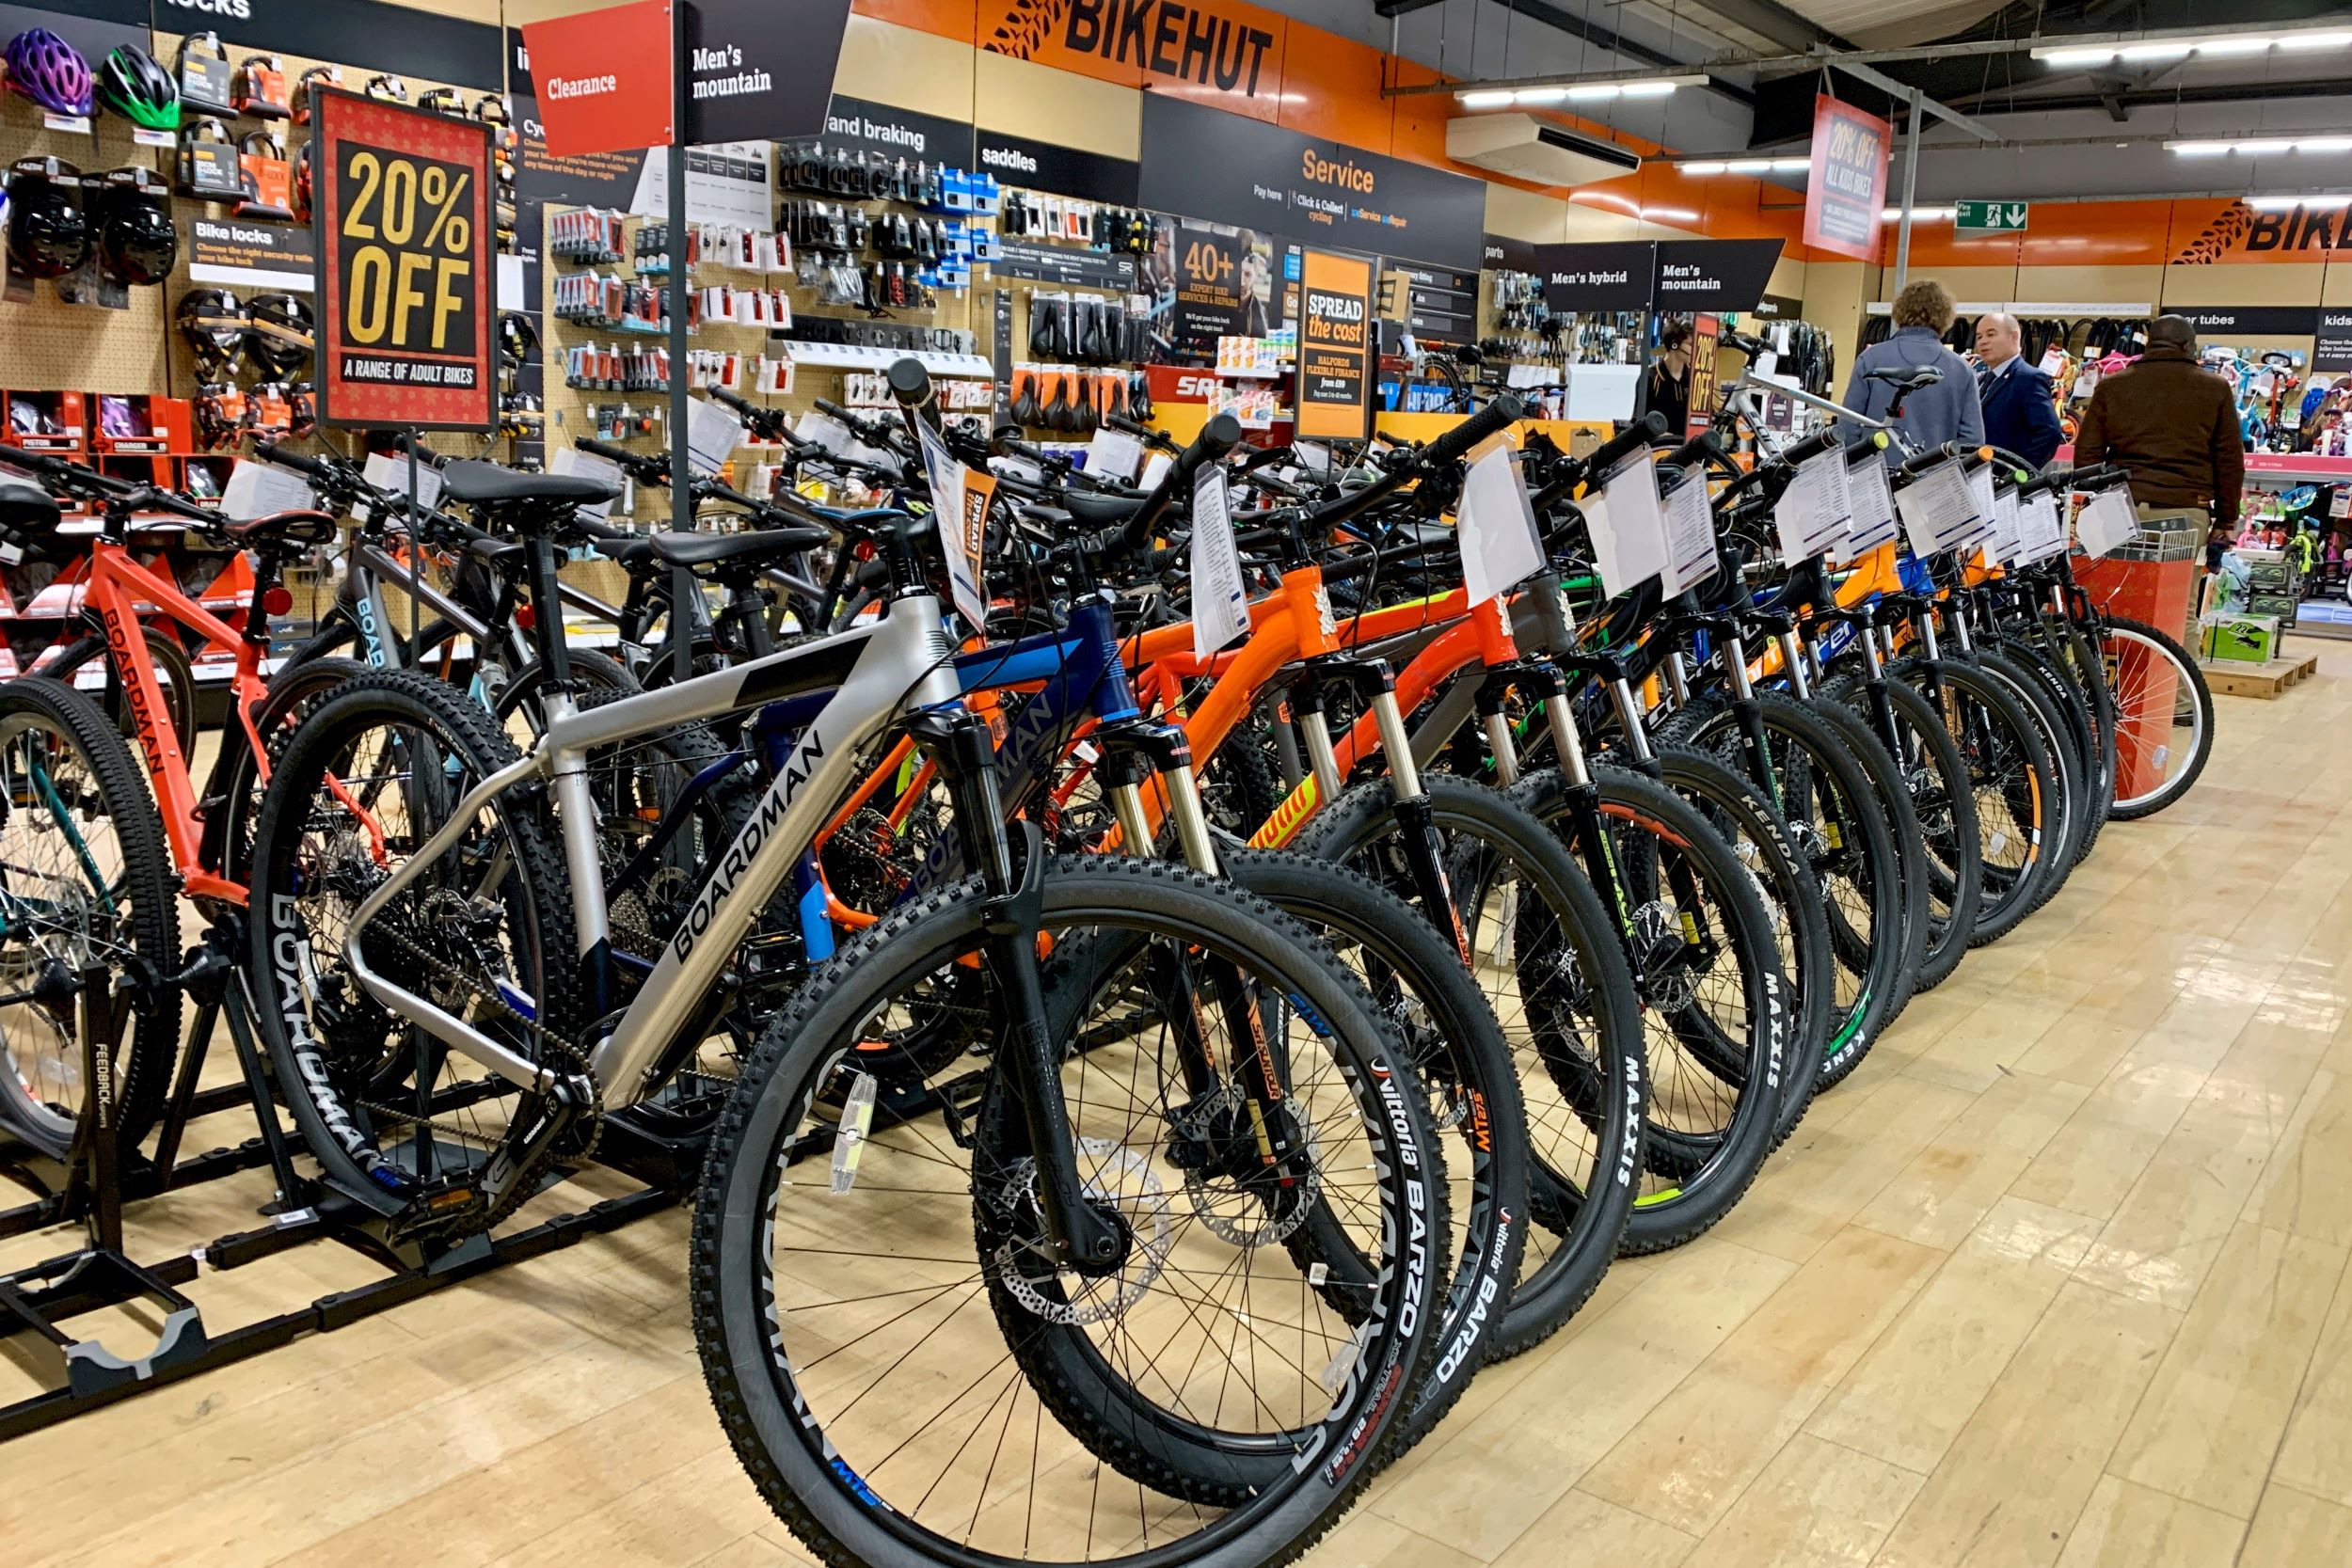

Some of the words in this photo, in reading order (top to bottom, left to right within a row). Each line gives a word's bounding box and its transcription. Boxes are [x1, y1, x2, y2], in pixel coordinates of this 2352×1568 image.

[692, 43, 742, 71] Men's
[1064, 0, 1273, 98] BIKEHUT
[548, 74, 617, 100] Clearance
[692, 68, 772, 99] mountain
[828, 117, 860, 136] and
[864, 119, 925, 152] braking
[982, 148, 1038, 173] saddles
[1302, 149, 1375, 194] Service
[343, 151, 469, 254] 20%
[1253, 183, 1266, 199] Pay
[1266, 188, 1282, 201] here
[1296, 193, 1314, 209] Click
[1321, 199, 1344, 214] Collect
[195, 221, 230, 241] Bike
[231, 226, 273, 245] locks
[1309, 210, 1333, 226] cycling
[1184, 241, 1233, 281] 40+
[1485, 245, 1504, 259] parts
[1551, 272, 1586, 284] Men's
[1588, 270, 1627, 285] hybrid
[1661, 277, 1721, 291] mountain
[1662, 264, 1700, 277] Men's
[347, 245, 470, 349] OFF
[1308, 293, 1363, 321] SPREAD
[1309, 314, 1331, 339] the
[1332, 322, 1362, 342] cost
[2200, 313, 2235, 325] tubes
[2324, 314, 2352, 326] kids
[1317, 355, 1350, 368] HALFORDS
[1695, 335, 1715, 371] 20%
[344, 358, 354, 376] A
[355, 360, 391, 378] RANGE
[393, 363, 408, 380] OF
[409, 364, 442, 384] ADULT
[444, 367, 474, 386] BIKES
[1692, 372, 1711, 411] OFF
[113, 441, 148, 450] CHARGER
[966, 492, 977, 517] the
[970, 493, 984, 552] SPREAD
[104, 609, 166, 774] BOARDMAN
[2038, 665, 2069, 700] KENDA
[674, 729, 825, 965] BOARDMAN
[1740, 794, 1800, 876] KENDA
[1763, 971, 1779, 1090] MAXXIS
[95, 1043, 111, 1105] FEEDBACK
[1258, 1044, 1279, 1101] SUNTOUR
[523, 1115, 547, 1145] SRAM
[1618, 1054, 1640, 1190] MAXXIS
[1398, 1179, 1426, 1338] BARZO
[1436, 1274, 1499, 1384] BARZO
